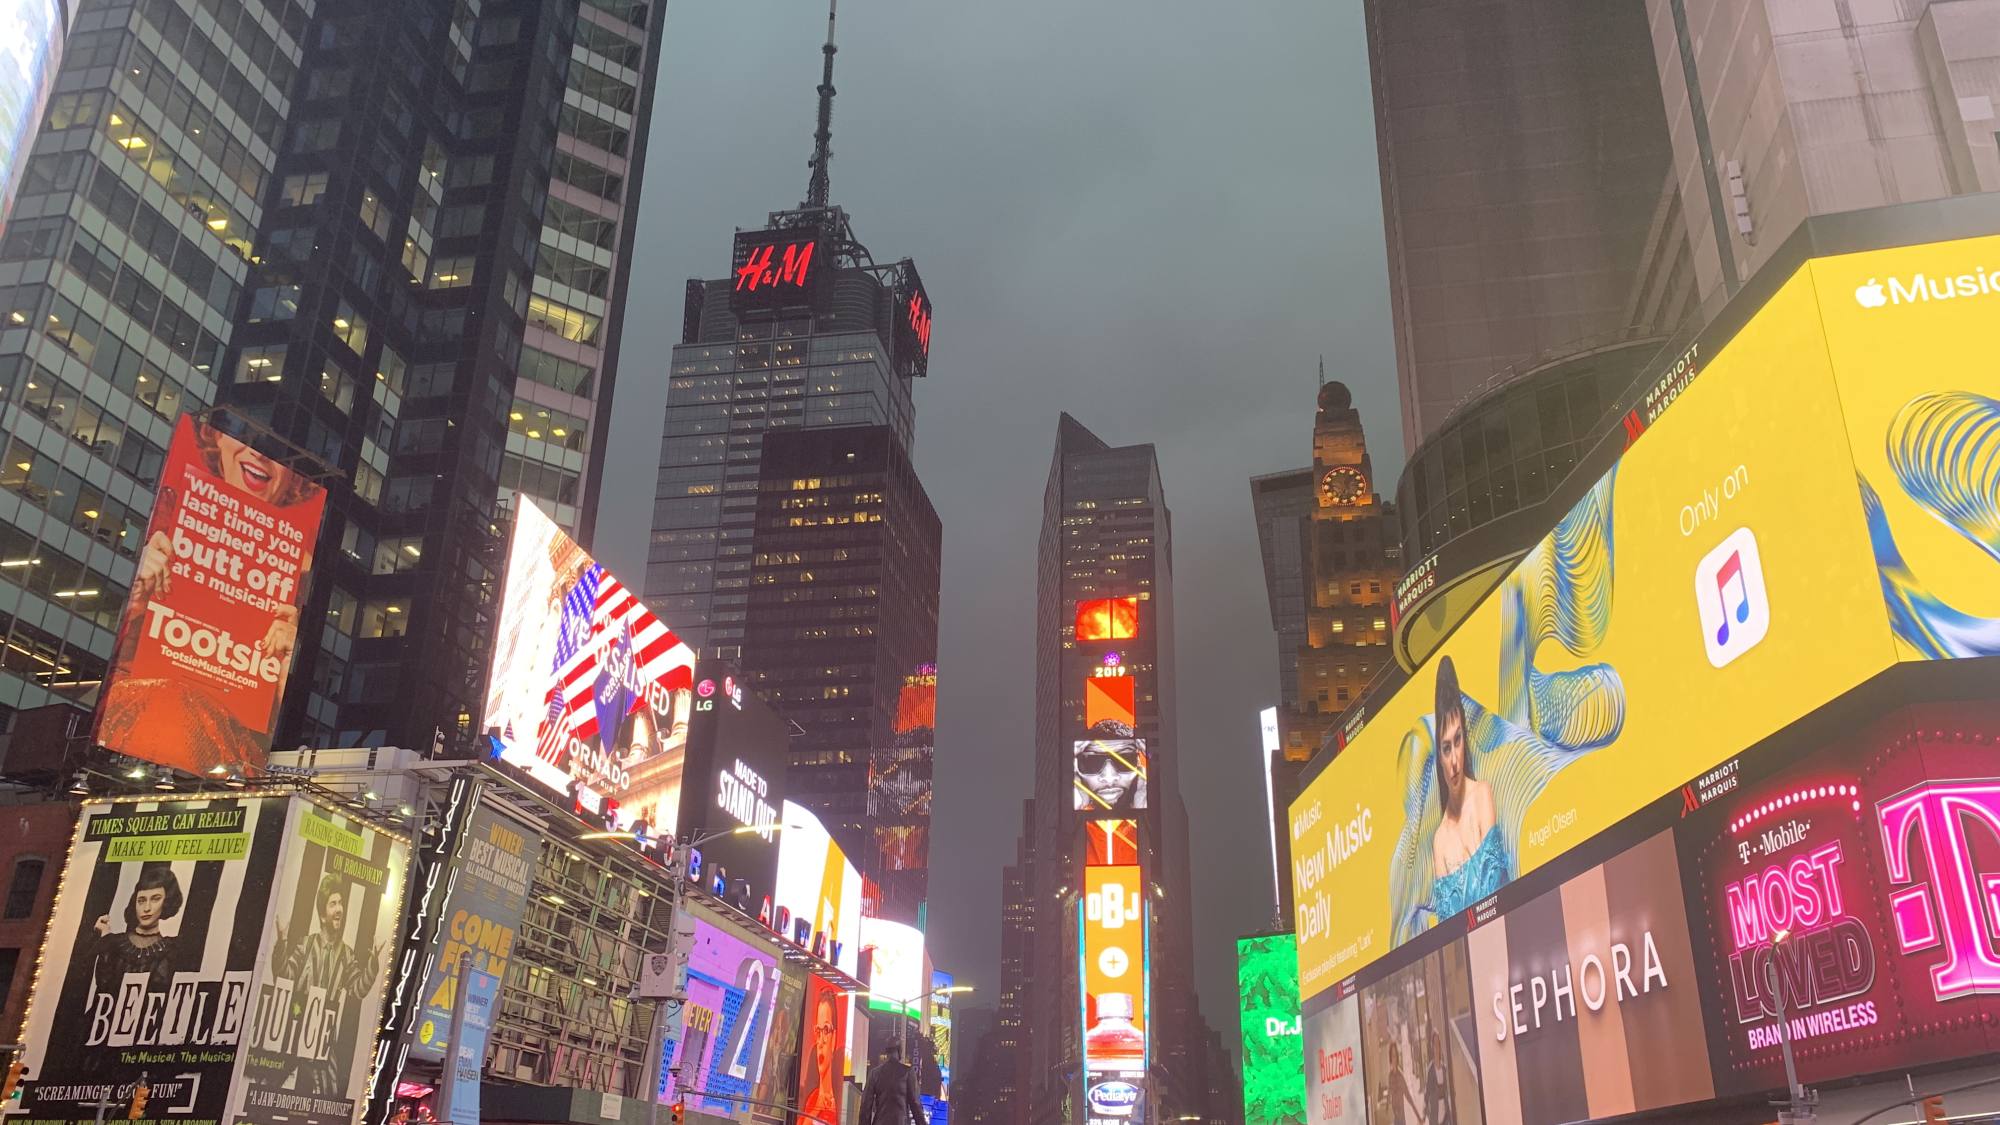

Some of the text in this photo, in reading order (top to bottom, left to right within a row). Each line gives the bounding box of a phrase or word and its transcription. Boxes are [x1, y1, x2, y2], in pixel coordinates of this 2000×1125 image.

[737, 241, 815, 292] H&M
[909, 289, 931, 356] H&M
[1646, 343, 1698, 407] MARRIOTT
[1649, 368, 1695, 424] MARQUIS
[1680, 464, 1749, 536] Only on
[177, 508, 297, 575] laughed your
[183, 490, 301, 559] last time you
[244, 505, 275, 529] was
[278, 520, 303, 542] the
[172, 561, 191, 578] at
[194, 571, 205, 584] a
[173, 527, 294, 602] butt off
[1398, 555, 1438, 599] MARRIOTT
[1399, 575, 1434, 614] MARQUIS
[147, 600, 281, 683] Tootsie
[161, 644, 258, 689] TootsieMusical.com
[1095, 666, 1125, 678] 2019
[696, 700, 713, 711] LG
[732, 684, 742, 703] LG
[734, 758, 767, 798] MADE TO
[1699, 759, 1739, 790] MARRIOTT
[1701, 776, 1737, 803] MARQUIS
[91, 811, 241, 835] TIMES SQUARE CAN REALLY
[718, 770, 777, 843] STAND OUT
[1299, 800, 1322, 835] Music
[111, 837, 245, 857] MAKE YOU FEEL ALIVE!
[305, 818, 359, 855] RAISING SPIRITS
[1529, 808, 1577, 848] Angel Olsen
[333, 854, 383, 886] ON BROADWAY!
[469, 838, 496, 867] BEST
[492, 848, 529, 885] MUSICAL
[1296, 802, 1373, 898] New Music
[1476, 895, 1498, 913] MARRIOTT
[1477, 907, 1497, 923] MARQUIS
[1725, 839, 1844, 952] MOST
[451, 909, 513, 959] COME
[1299, 890, 1331, 945] Daily
[1492, 931, 1668, 1042] SEPHORA
[1728, 916, 1876, 1024] LOVED
[85, 972, 251, 1047] BEETLE
[250, 978, 337, 1060] JUICE
[1791, 1017, 1807, 1041] IN
[1808, 1000, 1878, 1039] WIRELESS
[121, 1052, 137, 1064] The
[181, 1051, 197, 1063] The
[247, 1054, 258, 1066] The
[456, 1068, 479, 1081] HANSEN
[1318, 1046, 1354, 1085] Buzzaxe
[258, 1092, 311, 1111] JAW-DROPPING
